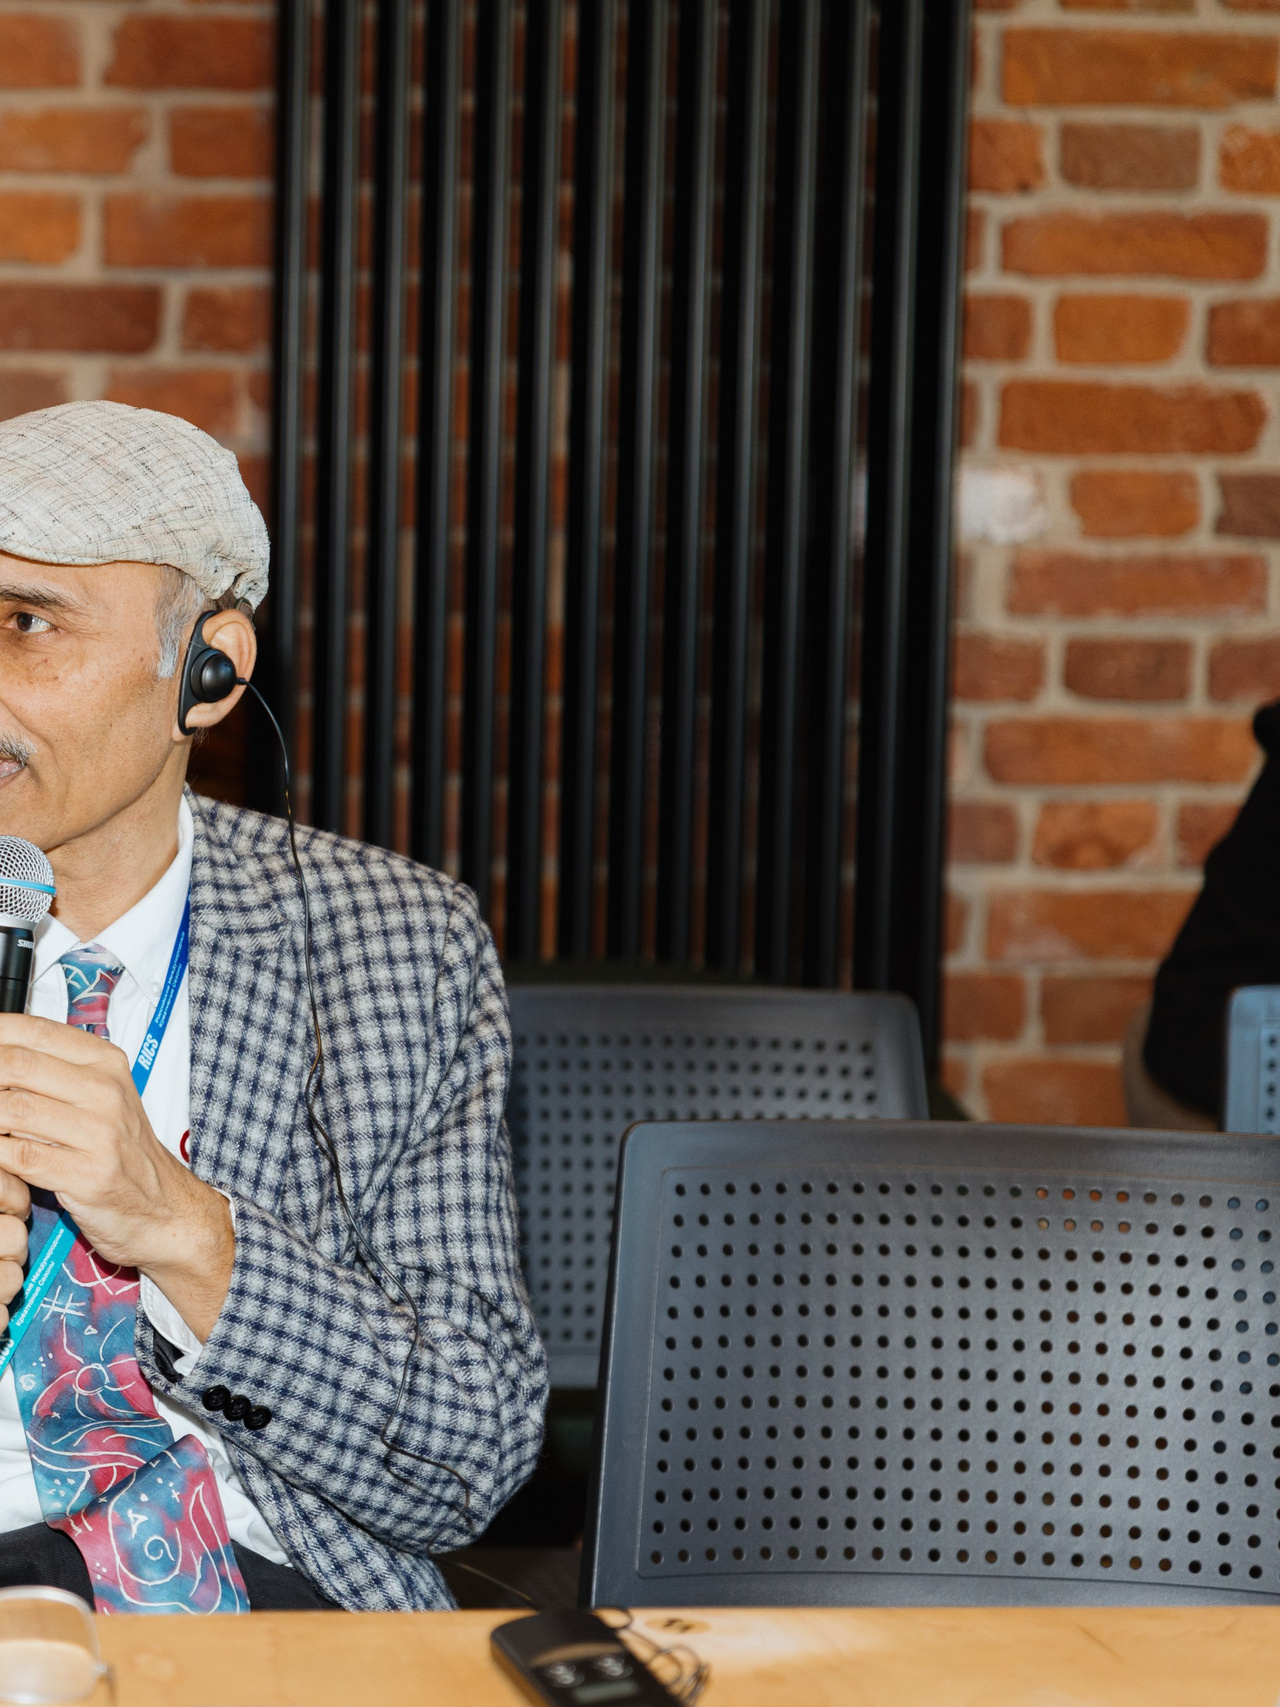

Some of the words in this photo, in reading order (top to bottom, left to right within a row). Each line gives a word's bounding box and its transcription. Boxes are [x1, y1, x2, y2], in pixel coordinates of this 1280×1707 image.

[154, 985, 170, 1024] Российские
[158, 988, 175, 1028] Креативные
[172, 963, 182, 988] Сезоны
[137, 1033, 159, 1071] RICS
[30, 1228, 64, 1284] Международные
[15, 1286, 41, 1327] Креативные
[38, 1260, 55, 1287] Сезоны
